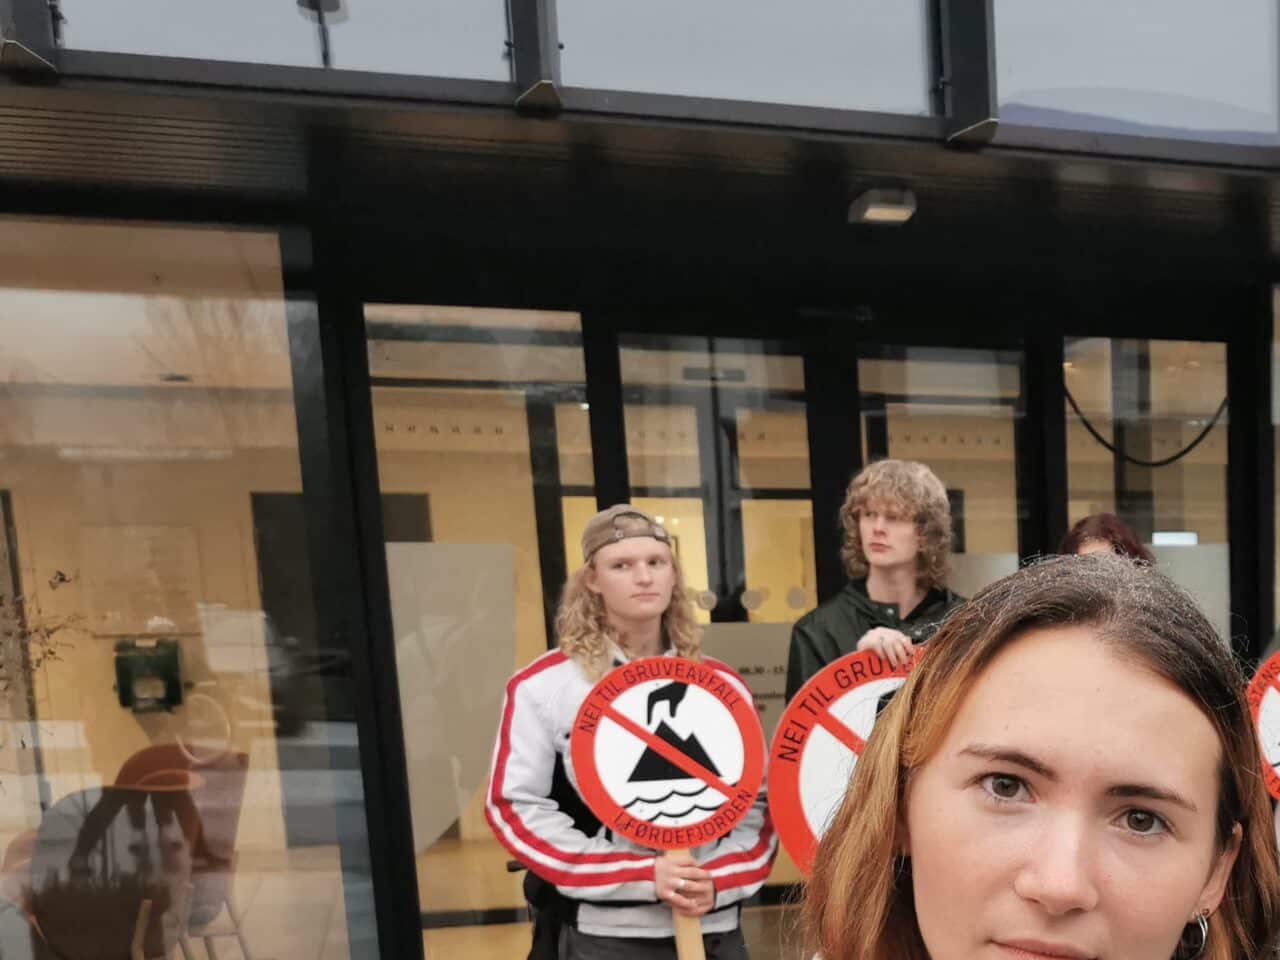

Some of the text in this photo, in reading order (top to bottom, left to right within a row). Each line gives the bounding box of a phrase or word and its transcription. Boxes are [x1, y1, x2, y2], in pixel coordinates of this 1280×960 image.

[577, 662, 741, 735] NEI TIL GRUVEAVFALL
[778, 719, 809, 763] NEI
[798, 687, 834, 718] TIL
[623, 790, 753, 845] FØRDEFJORDEN
